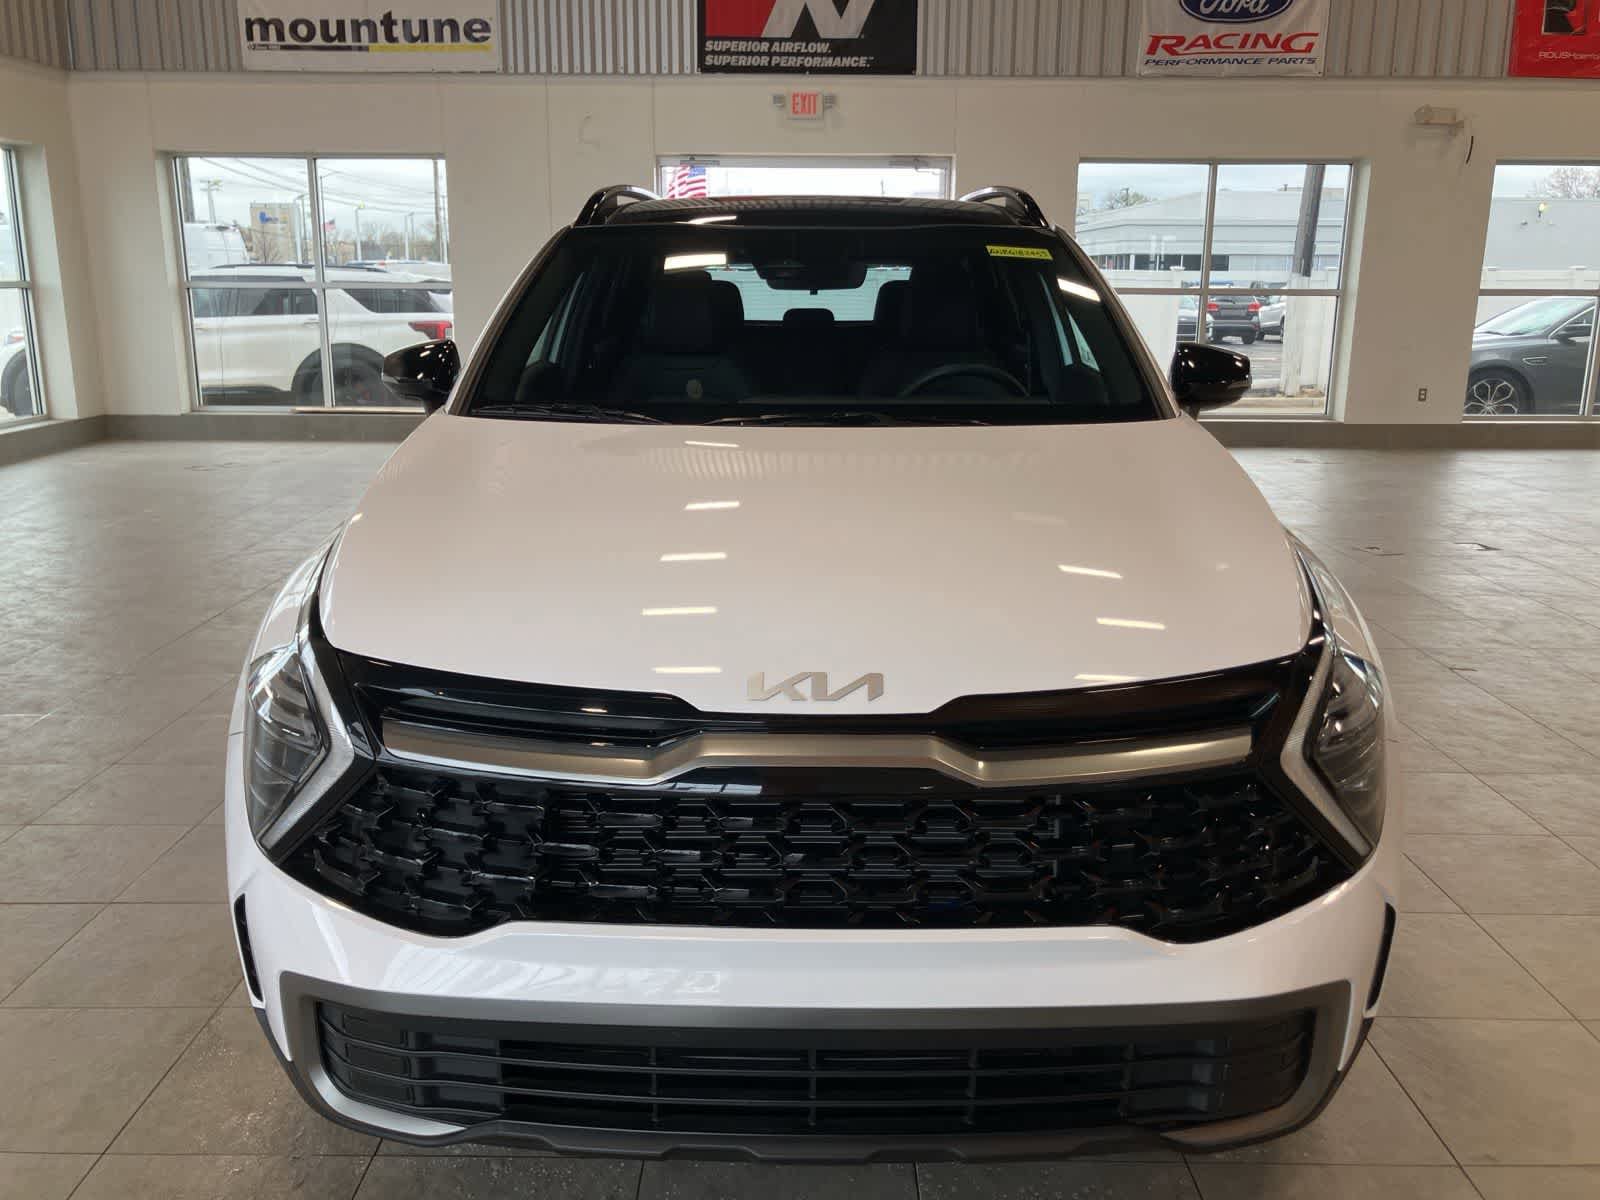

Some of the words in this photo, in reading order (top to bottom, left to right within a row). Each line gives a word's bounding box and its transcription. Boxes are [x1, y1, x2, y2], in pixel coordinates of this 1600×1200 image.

[245, 10, 492, 43] mountune
[705, 41, 770, 53] SUPERIOR
[771, 42, 832, 53] AIRFLOW.
[1146, 32, 1319, 56] RACING
[705, 55, 769, 66] SUPERIOR
[1144, 57, 1263, 66] PERFORMANCE
[1268, 57, 1318, 65] PARTS
[792, 92, 817, 115] EXIT
[747, 671, 884, 702] KIA
